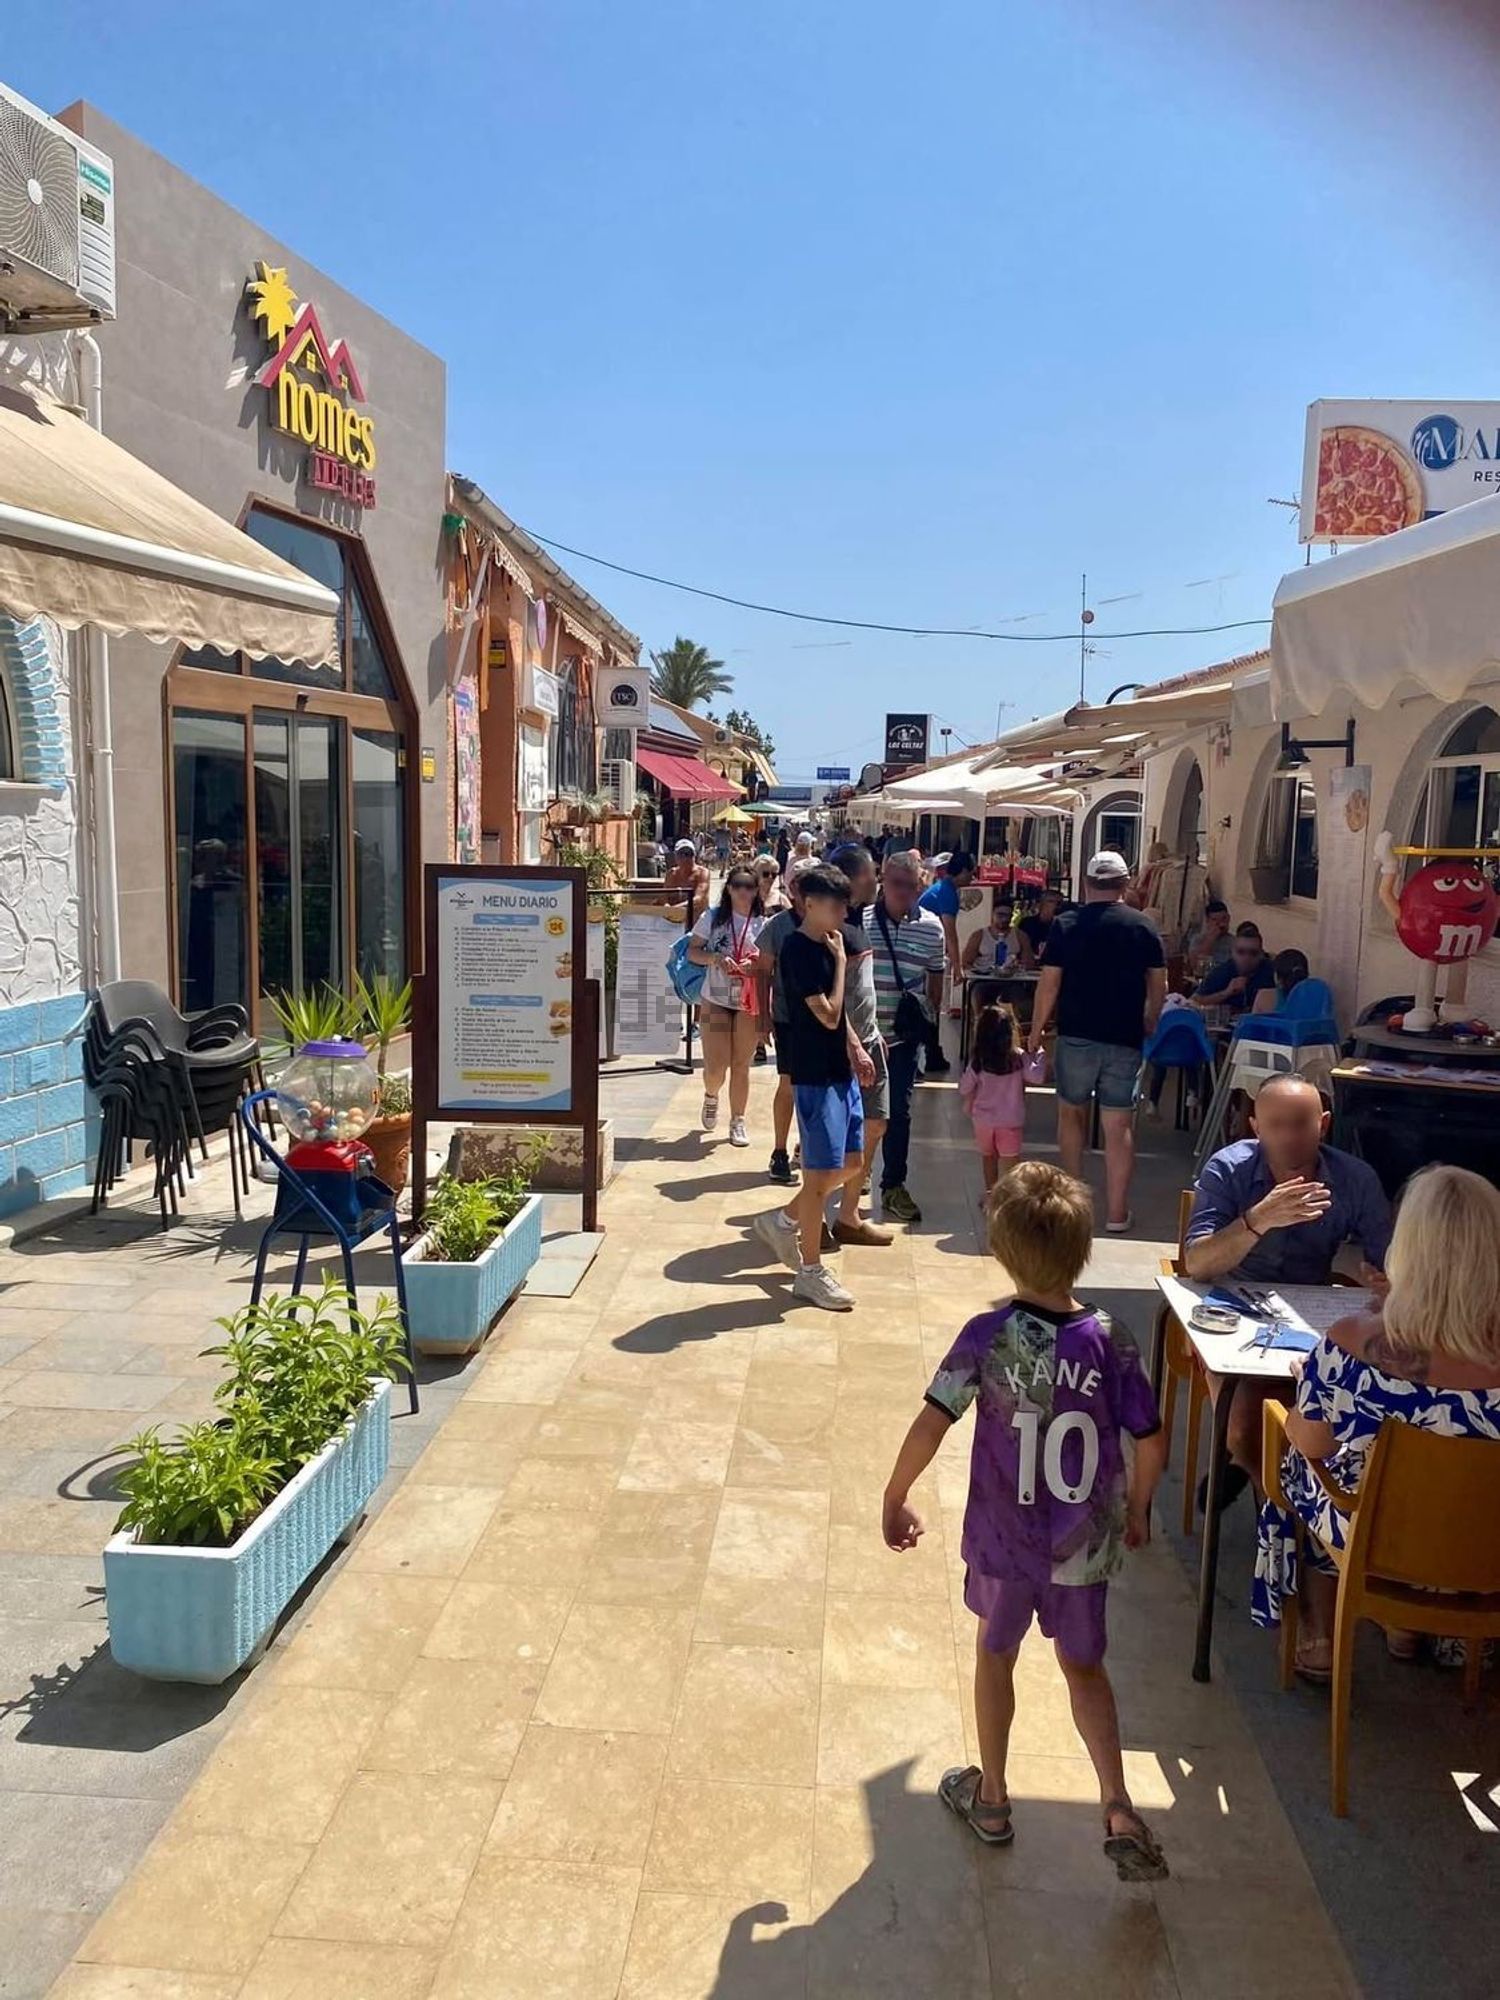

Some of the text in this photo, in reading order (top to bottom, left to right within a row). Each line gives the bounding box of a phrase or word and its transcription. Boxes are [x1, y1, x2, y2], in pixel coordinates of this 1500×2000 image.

[279, 370, 376, 471] homes
[1427, 427, 1500, 460] MA
[482, 895, 517, 908] MENU
[519, 896, 558, 909] DIARIO
[1434, 924, 1482, 957] m
[1004, 1358, 1102, 1398] KANE
[1011, 1411, 1099, 1505] 10
